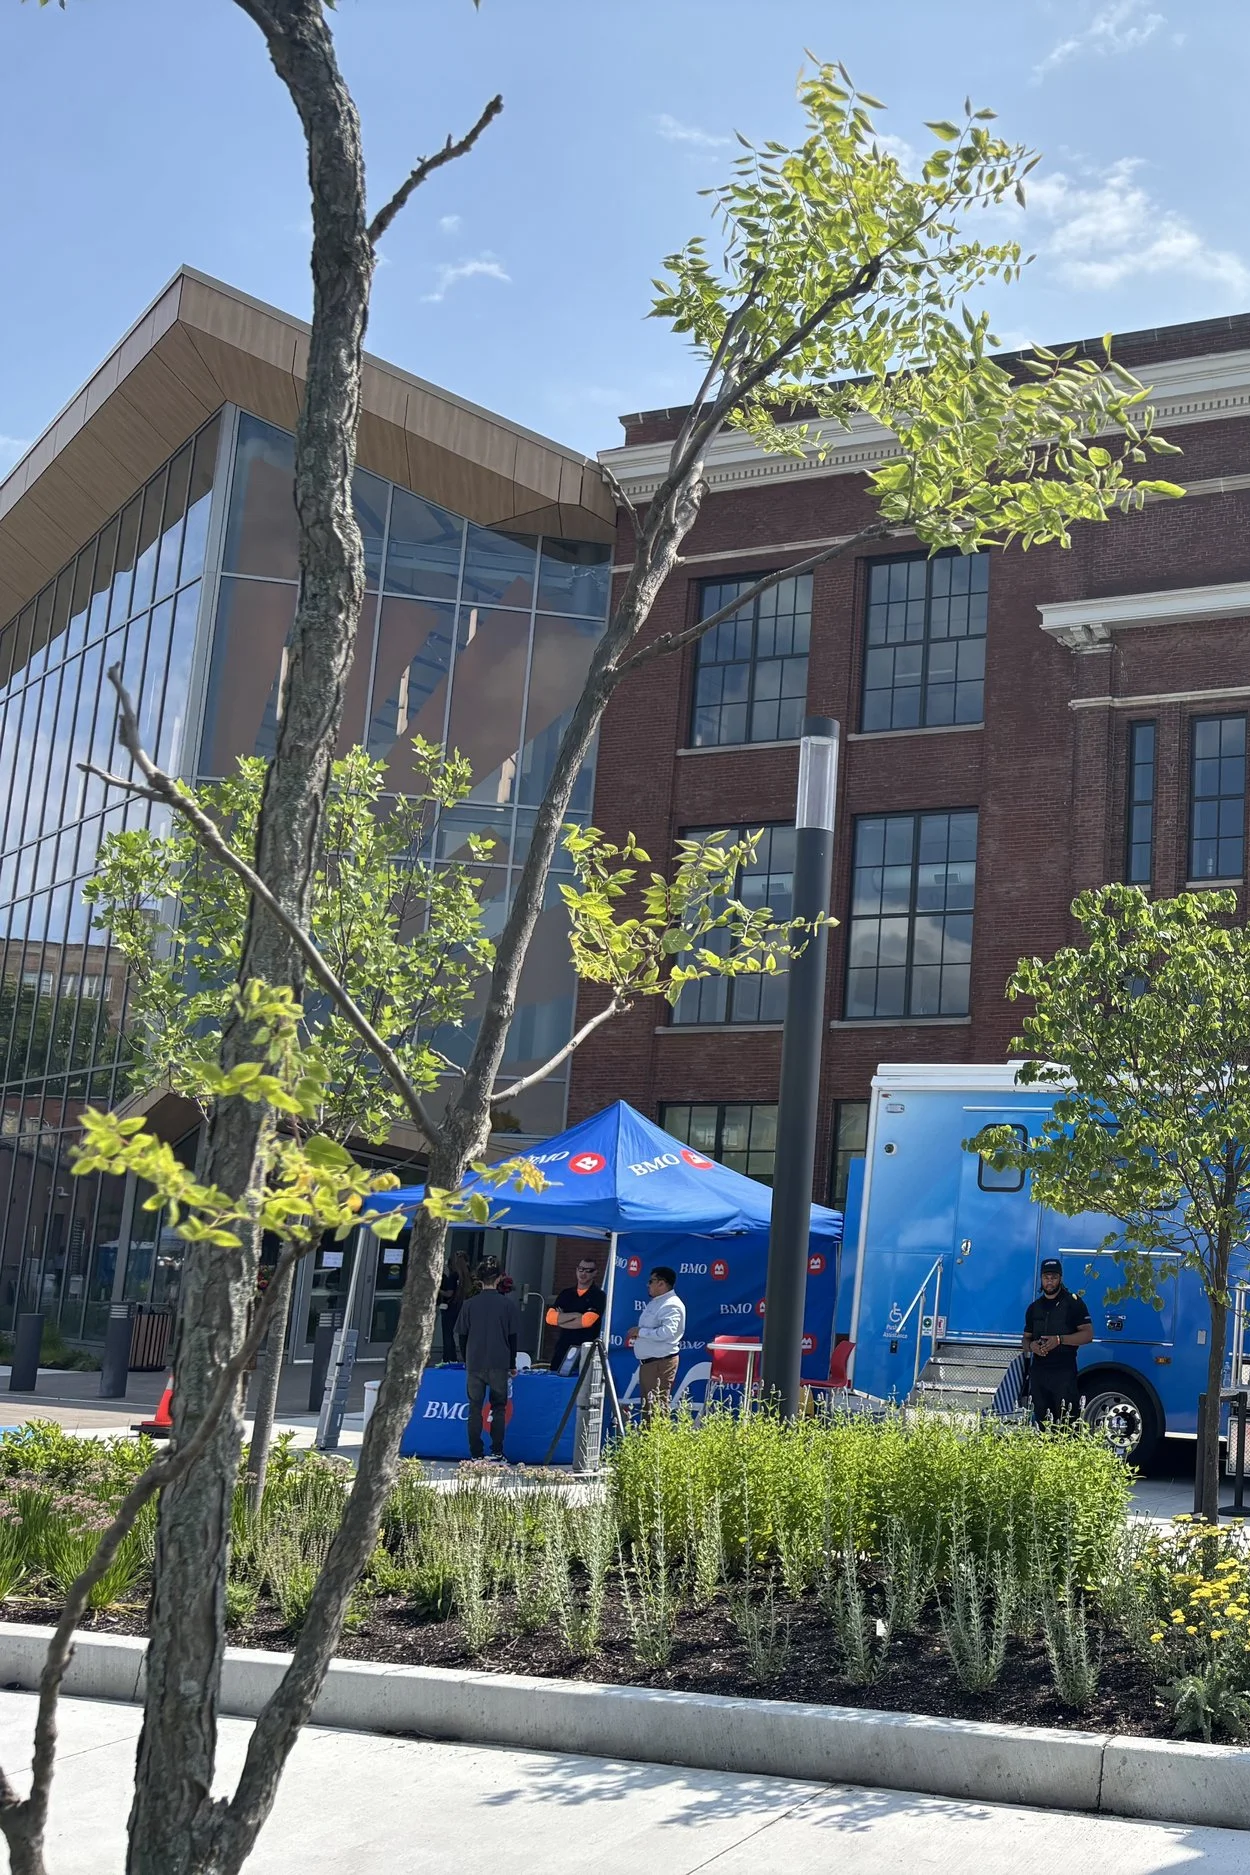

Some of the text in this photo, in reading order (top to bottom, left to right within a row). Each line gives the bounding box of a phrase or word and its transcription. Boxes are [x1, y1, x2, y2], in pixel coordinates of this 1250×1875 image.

[627, 1152, 681, 1177] BMO
[679, 1262, 708, 1275] BMO
[720, 1303, 752, 1315] BMO
[679, 1340, 706, 1350] BMO
